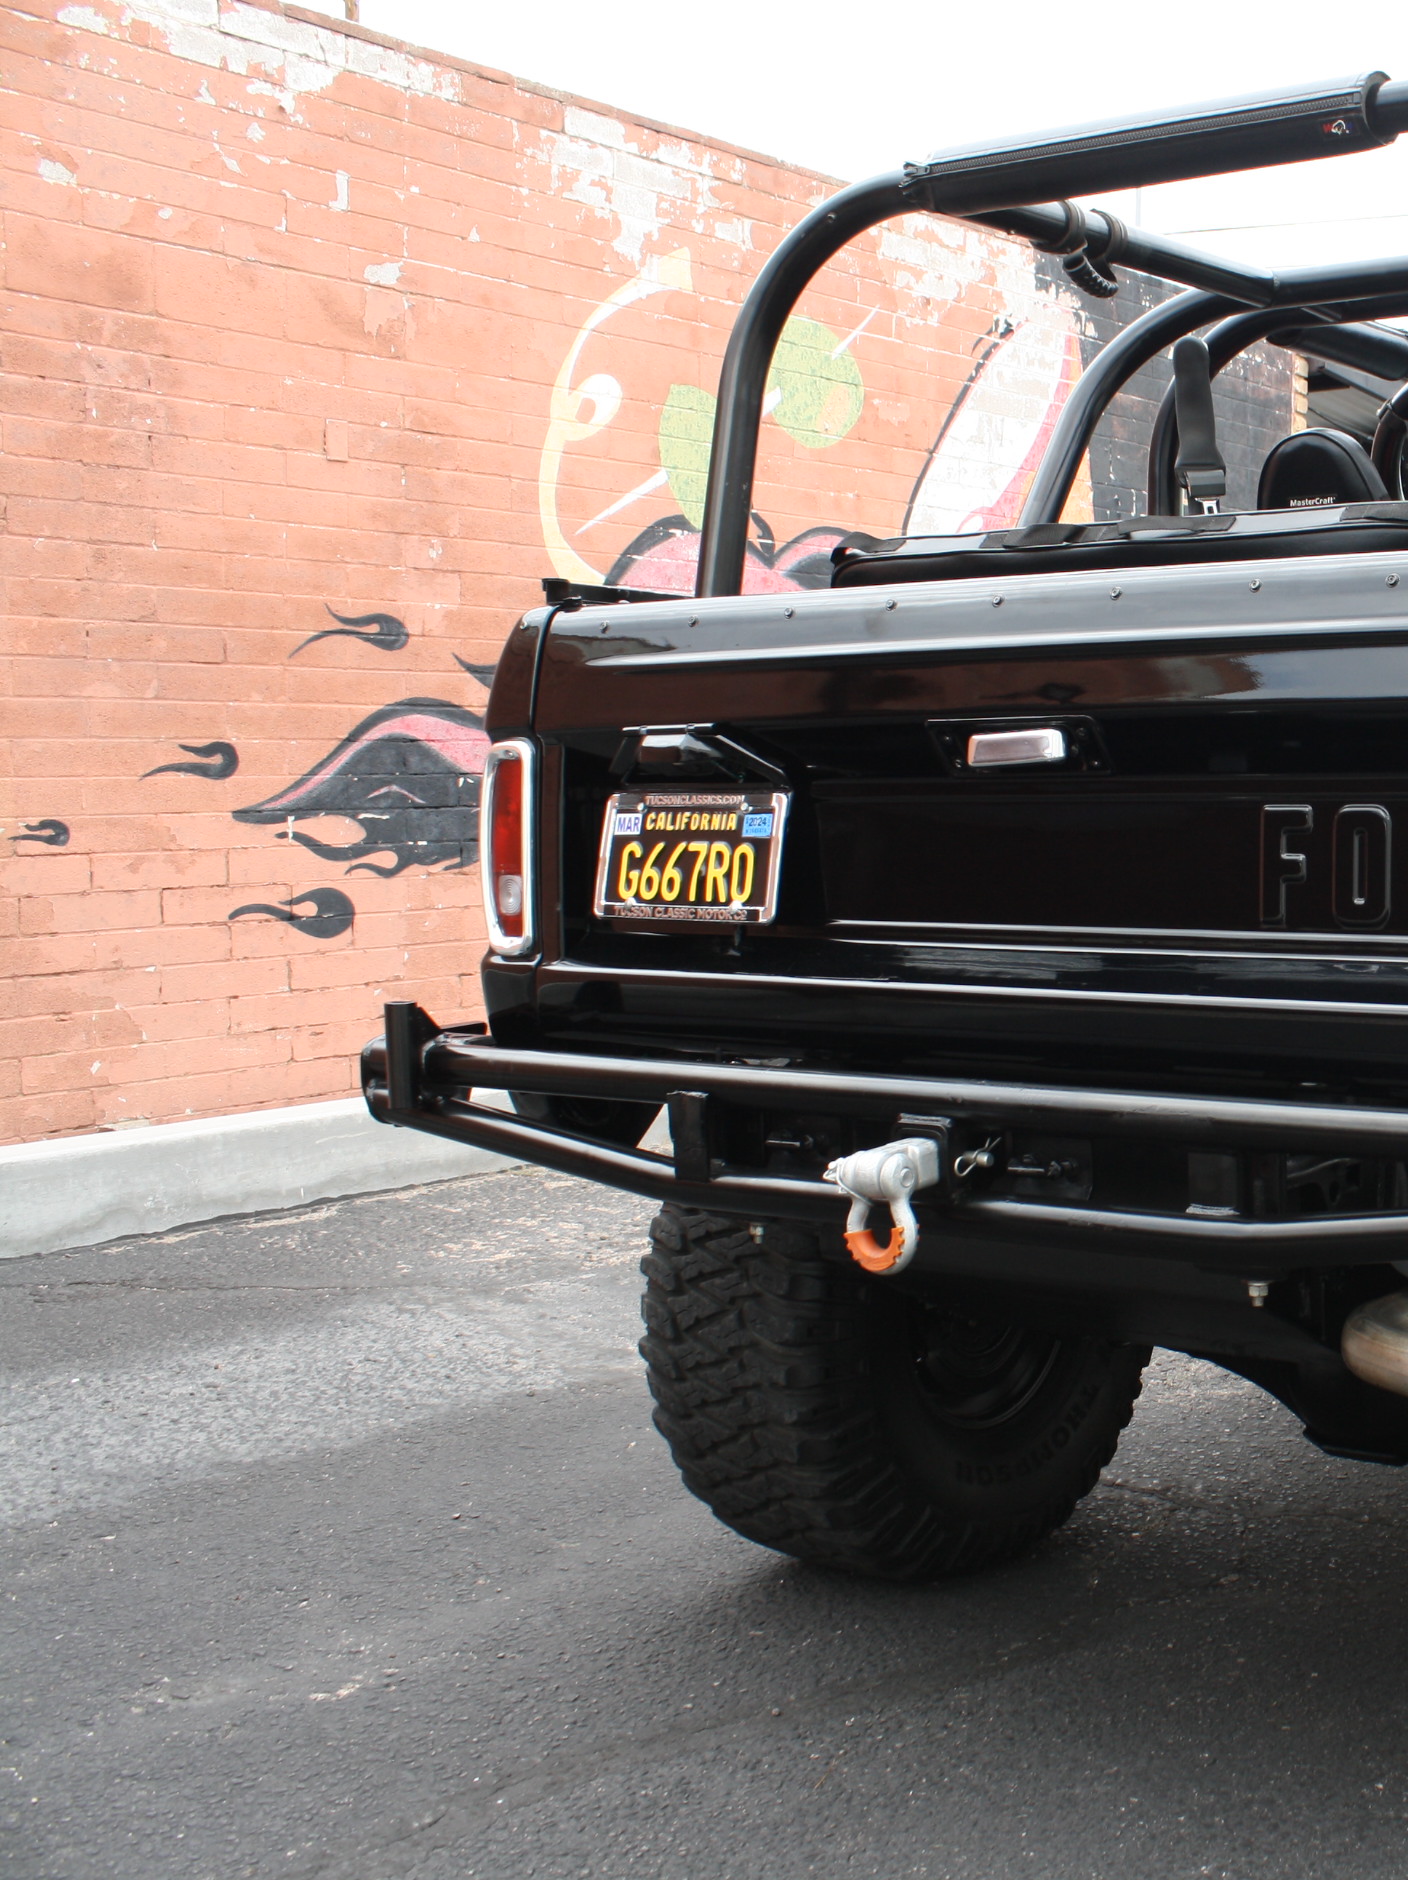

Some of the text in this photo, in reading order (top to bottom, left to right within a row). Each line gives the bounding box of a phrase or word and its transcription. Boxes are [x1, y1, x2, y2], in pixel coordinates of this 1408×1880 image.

[617, 816, 640, 832] MAR
[645, 812, 737, 831] CALIFORNIA
[749, 816, 767, 827] 2024
[613, 906, 652, 917] TUCSON
[654, 907, 696, 919] CLASSIC
[697, 909, 732, 920] MOTOR
